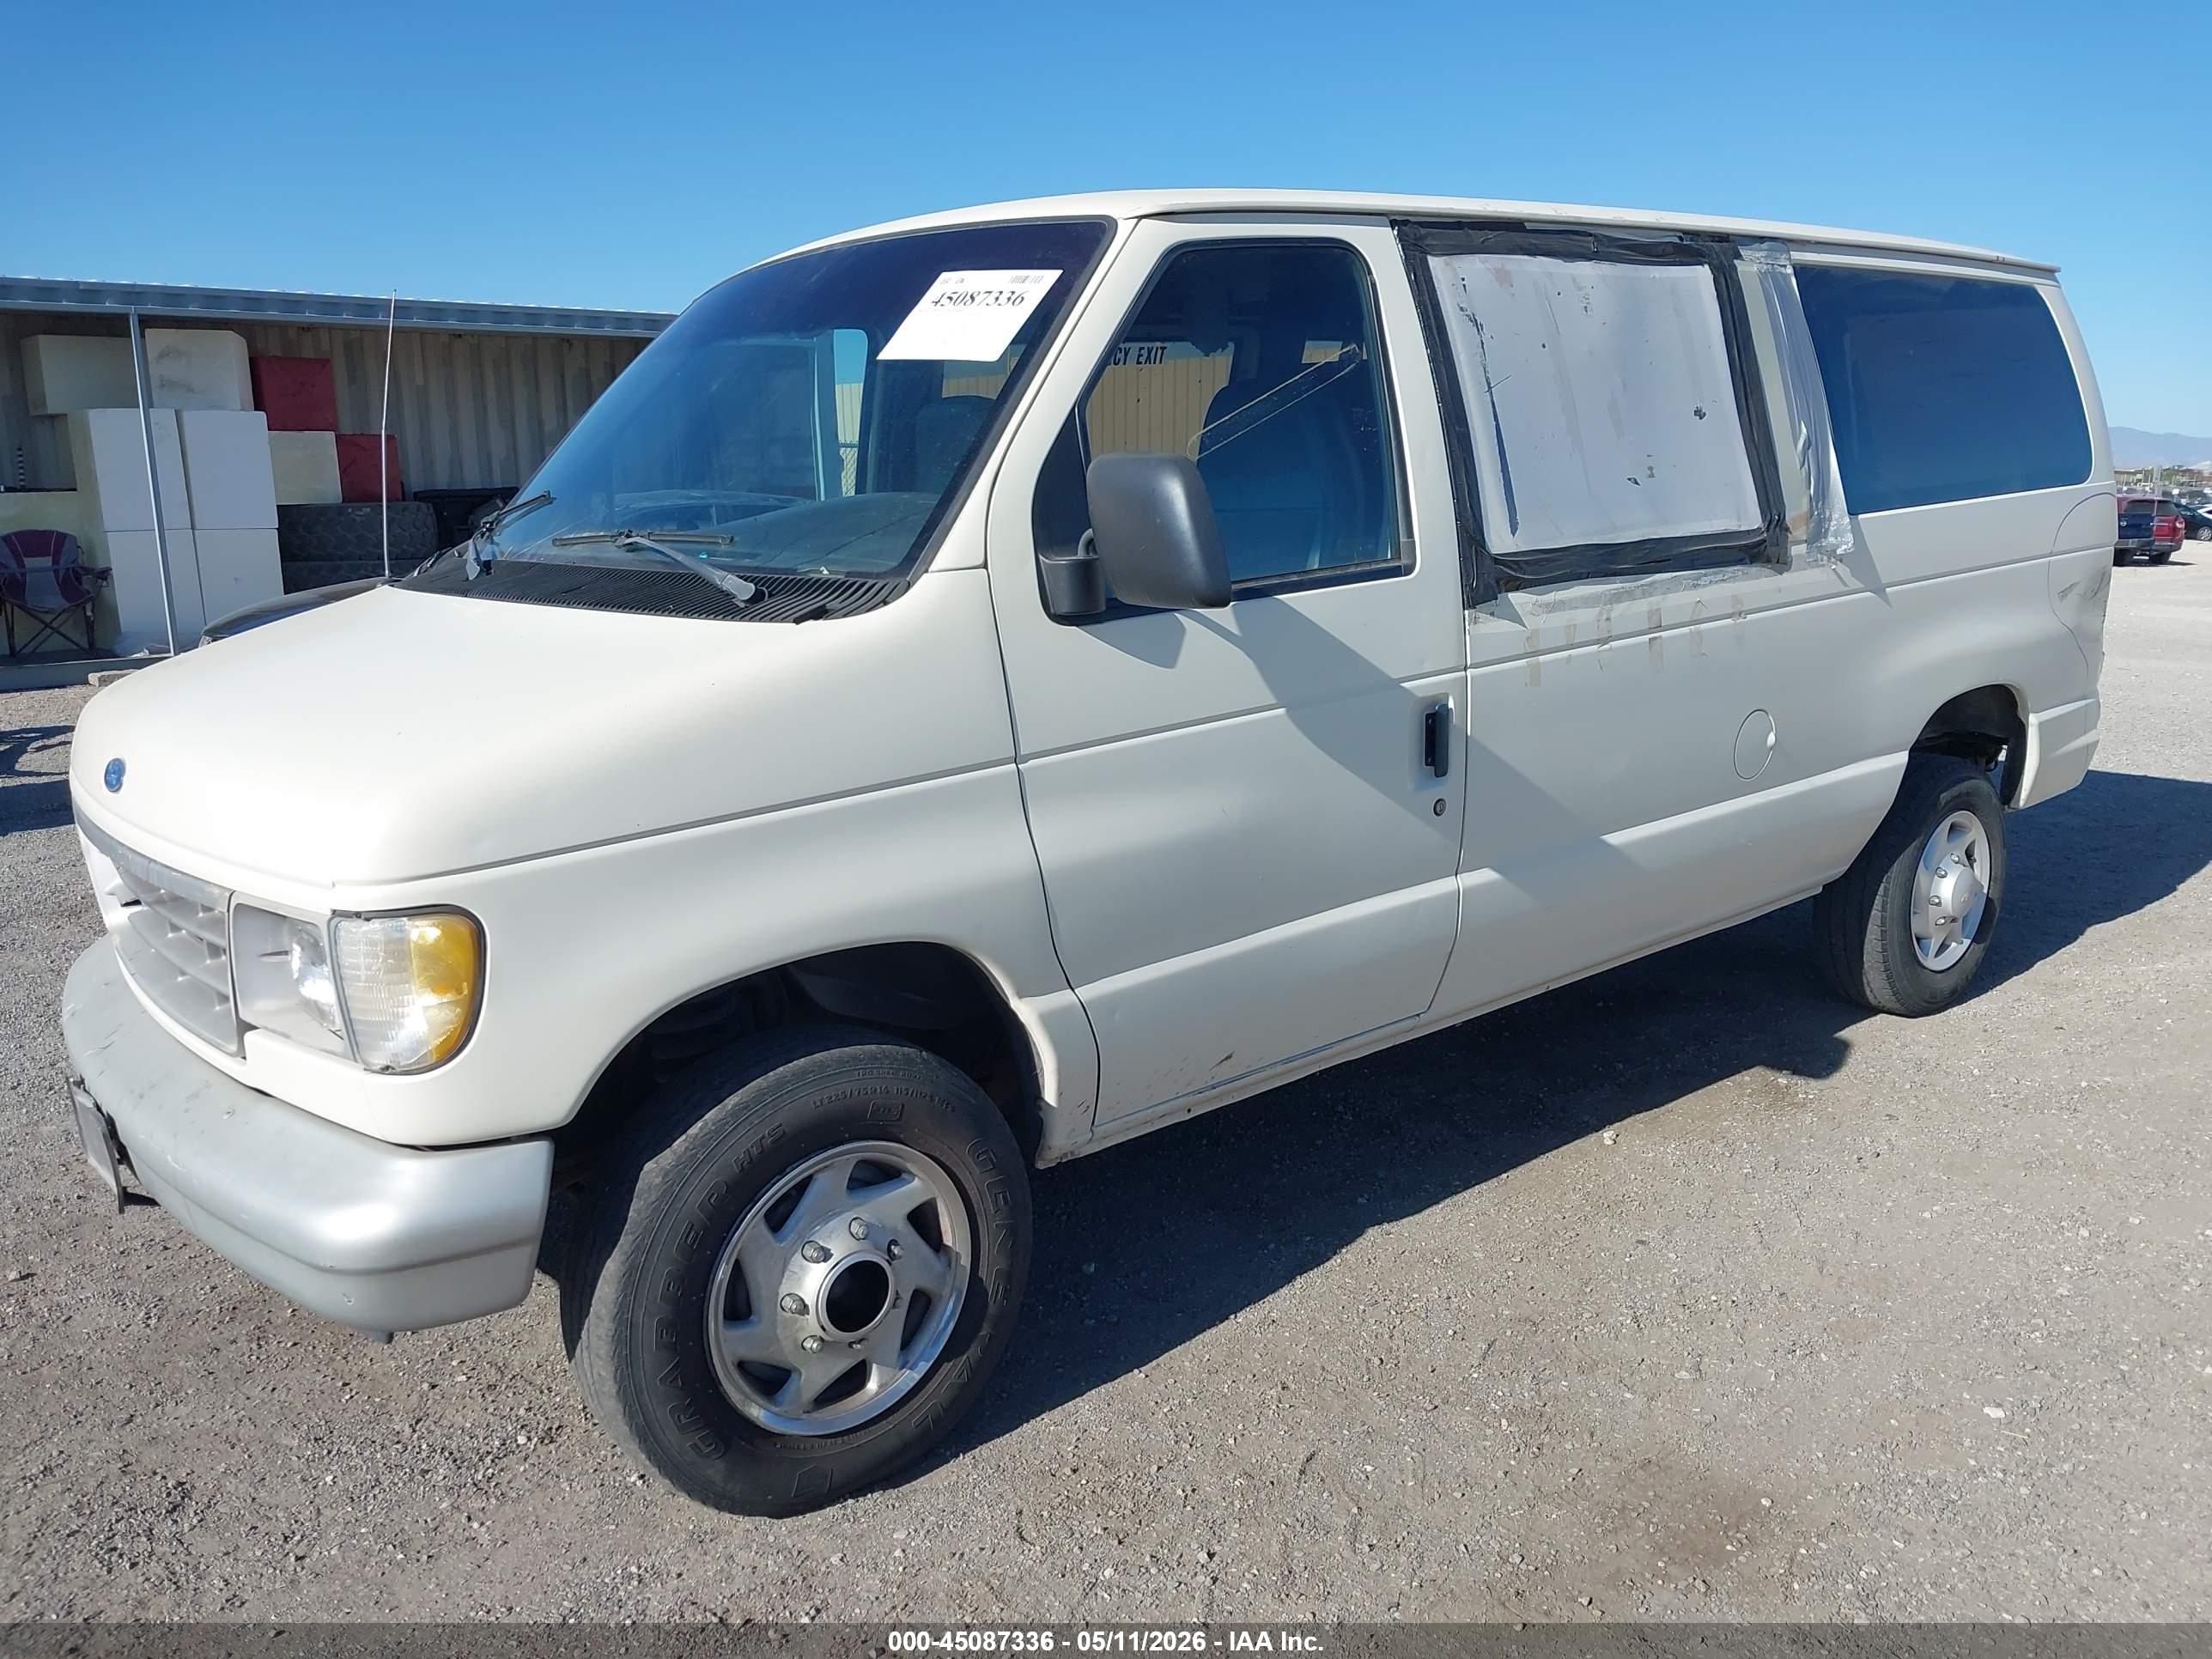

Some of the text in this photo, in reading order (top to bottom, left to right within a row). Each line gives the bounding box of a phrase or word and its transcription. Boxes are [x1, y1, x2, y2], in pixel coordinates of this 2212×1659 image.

[932, 290, 1030, 307] 45087336
[1136, 346, 1167, 365] EXIT
[732, 1121, 787, 1174] HTS
[654, 1179, 728, 1459] GRABBER
